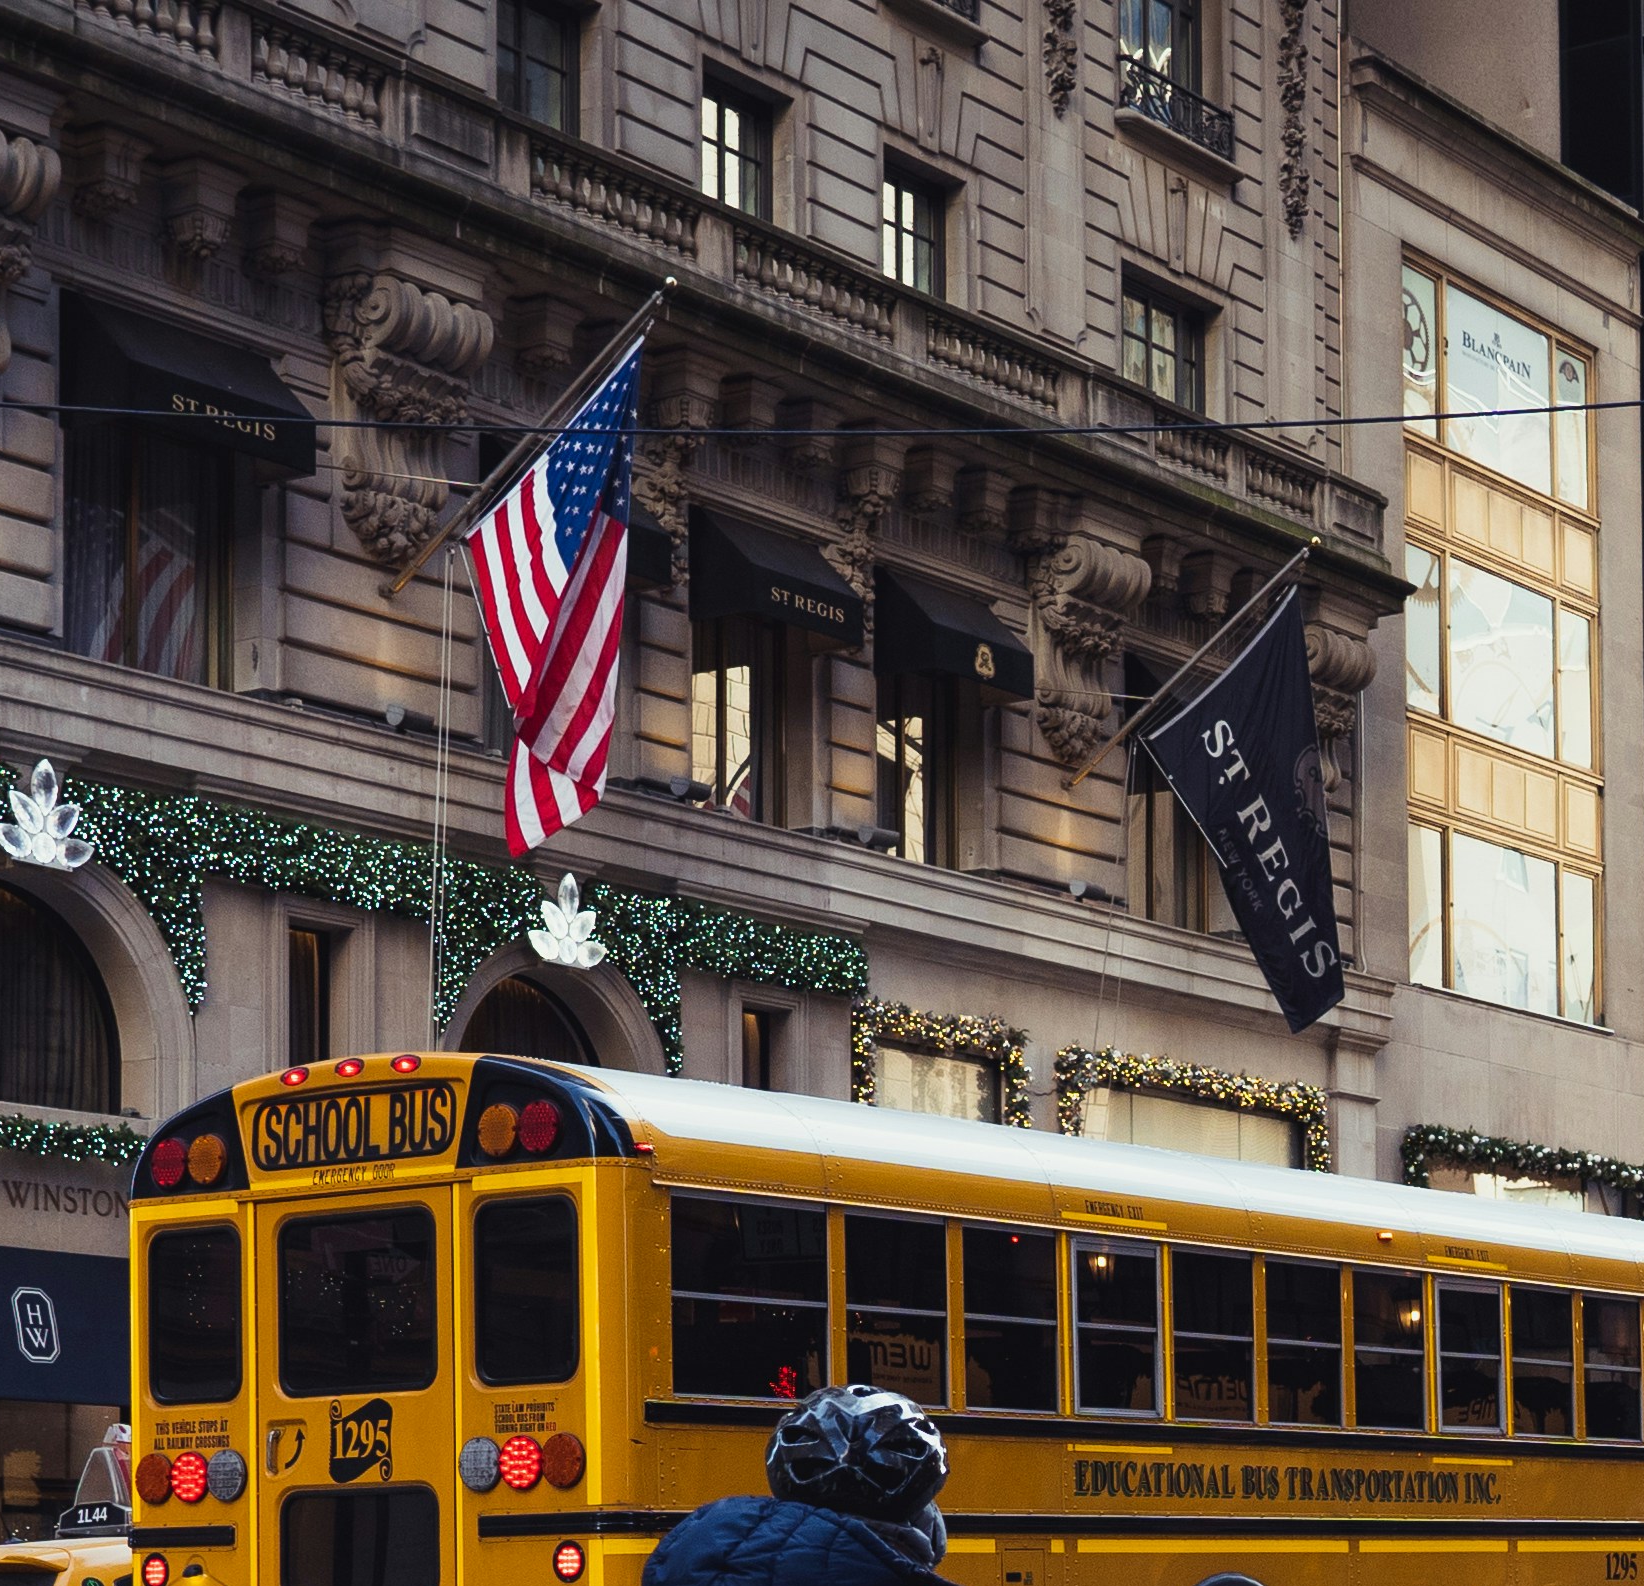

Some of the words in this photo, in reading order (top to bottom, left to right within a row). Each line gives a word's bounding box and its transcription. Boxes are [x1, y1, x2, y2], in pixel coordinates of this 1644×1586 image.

[795, 594, 845, 623] REGIS
[1218, 828, 1236, 865] NEW
[1237, 868, 1264, 912] YORK
[1236, 793, 1338, 978] REGIS
[264, 1096, 380, 1165] SCHOOL
[389, 1087, 447, 1155] BUS
[313, 1165, 366, 1185] EMERGENCY
[372, 1163, 395, 1180] DOOR
[2, 1178, 130, 1218] WINSTON
[1084, 1199, 1124, 1218] EMERGENCY
[1126, 1205, 1144, 1220] EXIT
[155, 1422, 170, 1435] THIS
[172, 1421, 196, 1434] VEHICLE
[198, 1420, 218, 1433] STOPS
[220, 1419, 228, 1432] AT
[333, 1420, 388, 1458] 1295
[545, 1421, 556, 1431] RED
[154, 1438, 165, 1450] ALL
[167, 1437, 193, 1449] RAILWAY
[195, 1434, 230, 1448] CROSSINGS
[1074, 1460, 1235, 1498] EDUCATIONAL
[1241, 1464, 1280, 1500] BUS
[1284, 1466, 1459, 1504] TRANSPORTATION
[1463, 1472, 1502, 1504] INC.
[77, 1506, 107, 1524] 1L44
[1605, 1552, 1637, 1580] 1295
